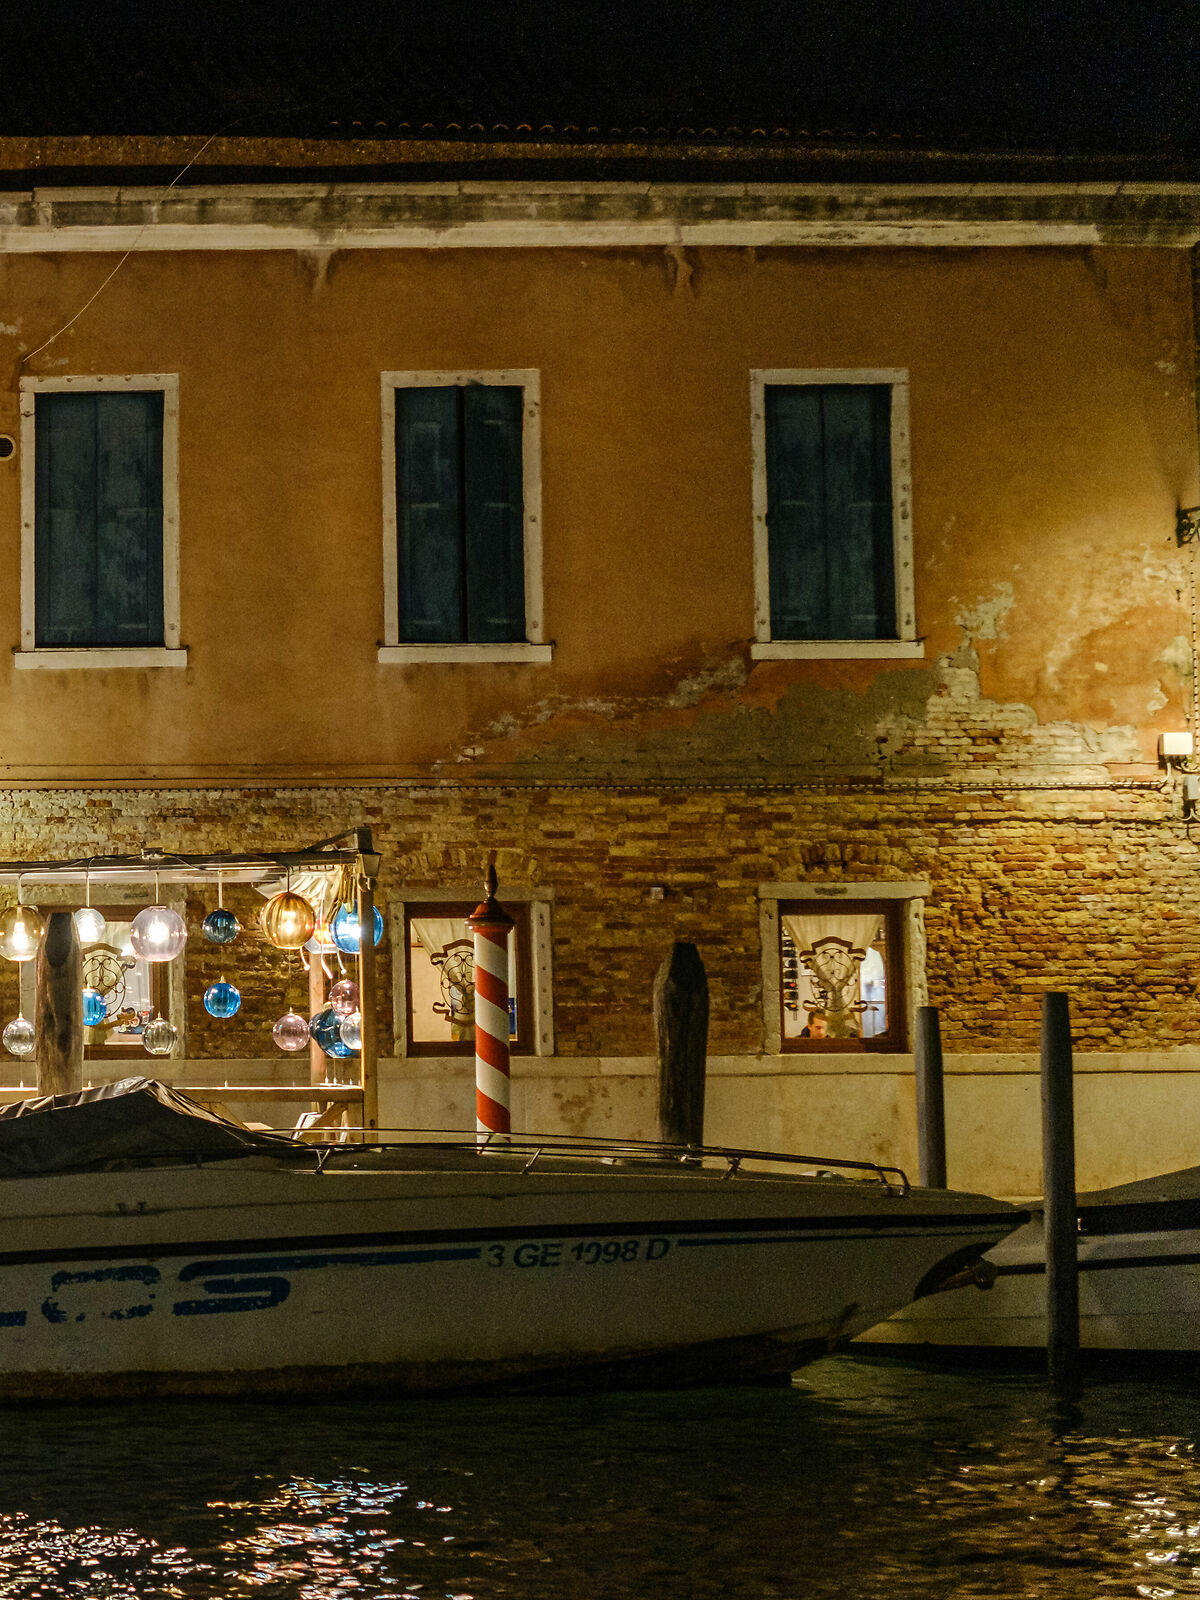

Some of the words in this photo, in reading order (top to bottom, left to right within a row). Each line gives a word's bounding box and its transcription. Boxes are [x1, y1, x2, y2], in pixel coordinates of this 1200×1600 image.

[486, 1244, 506, 1268] 3
[513, 1243, 564, 1268] GE
[646, 1238, 671, 1261] D
